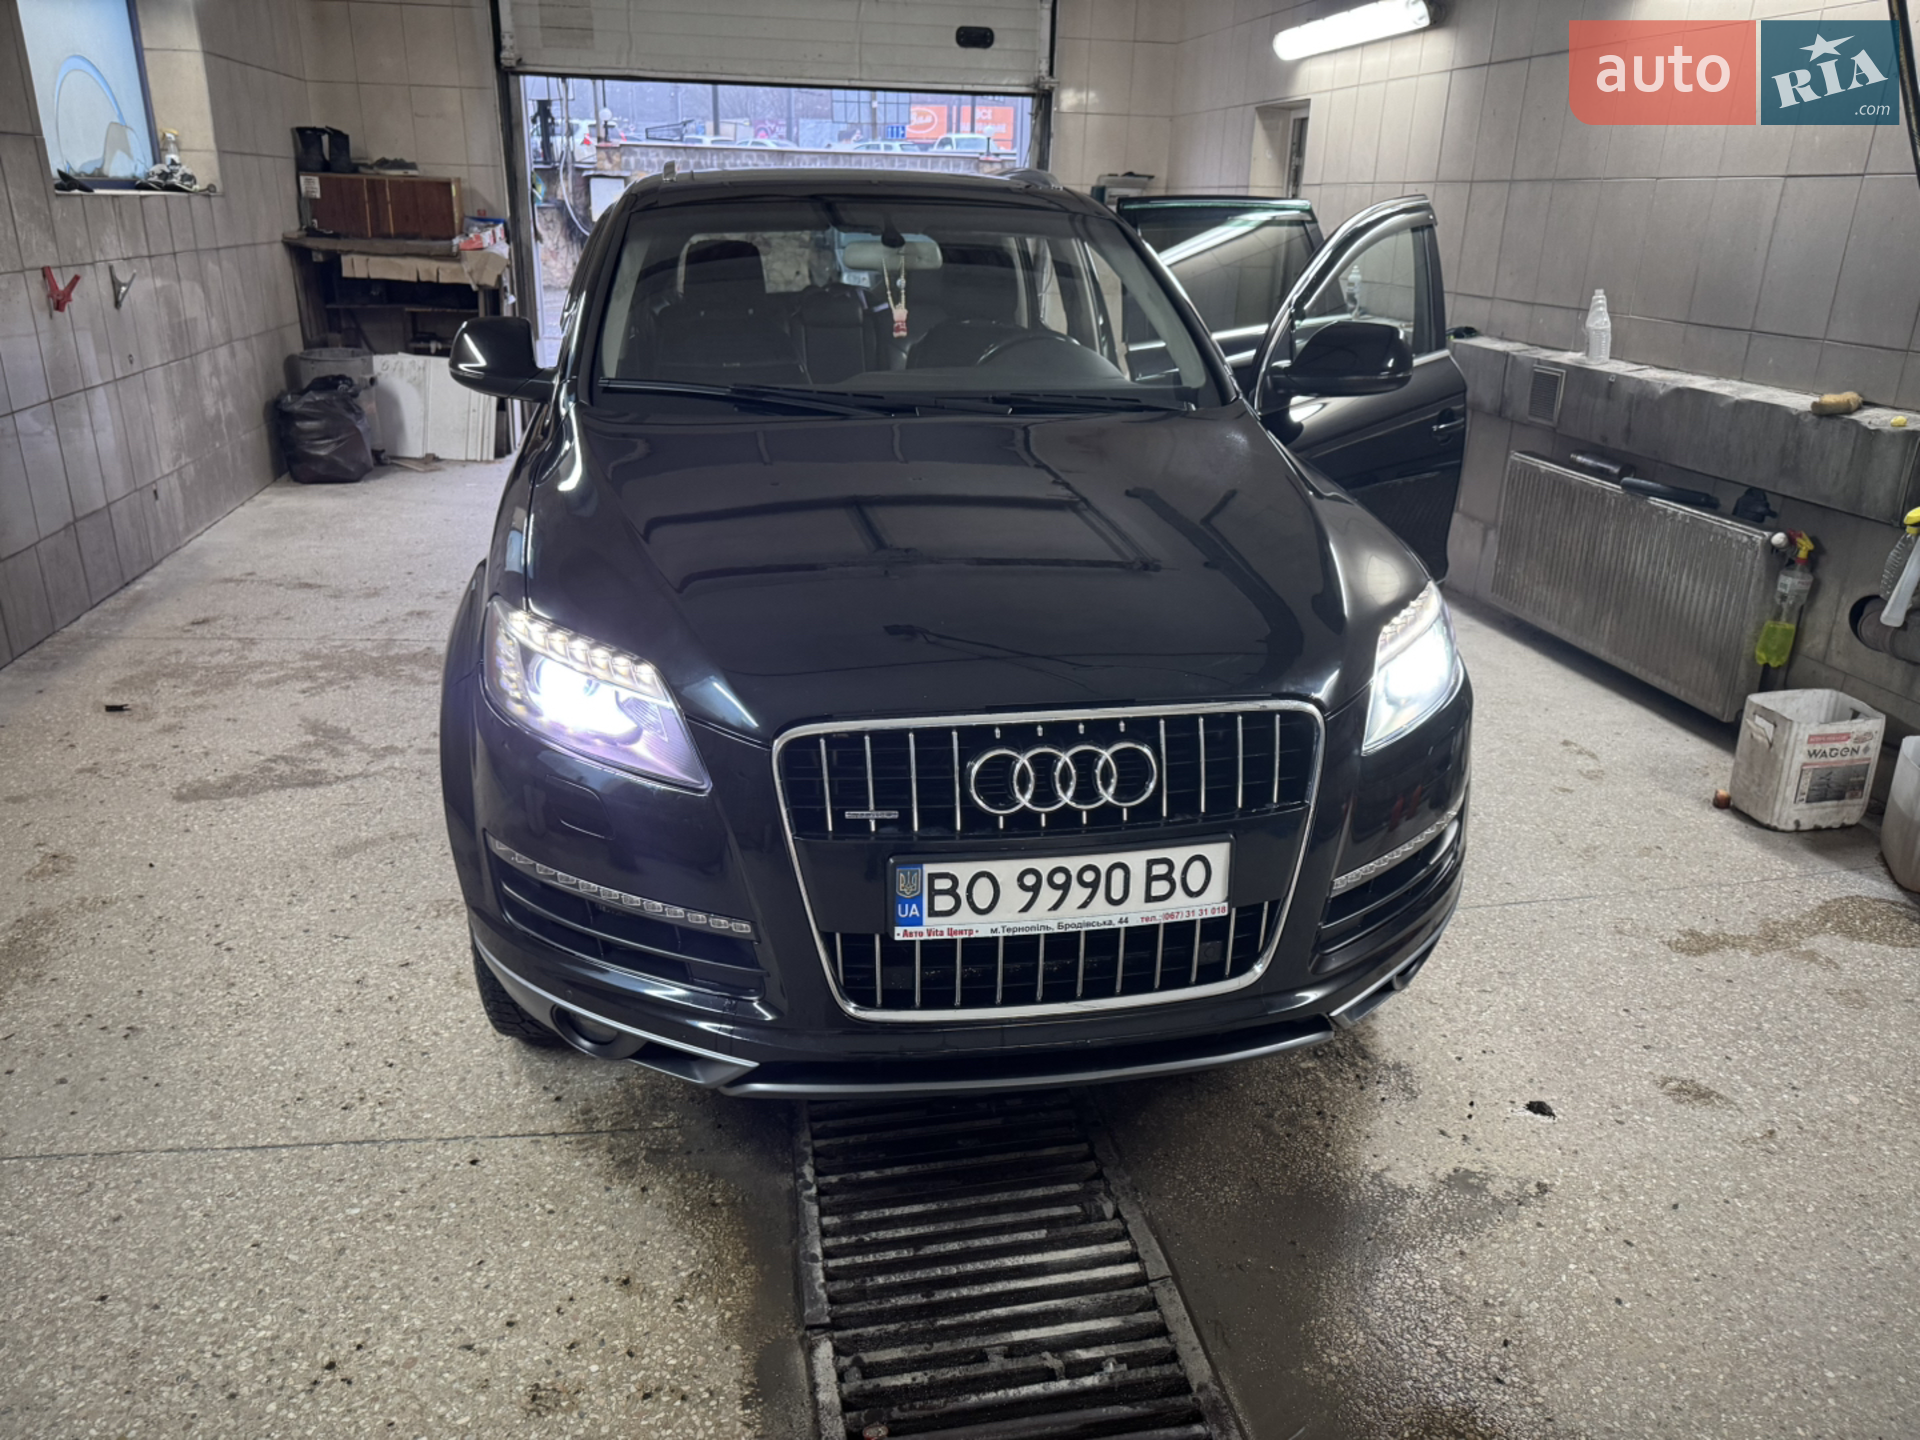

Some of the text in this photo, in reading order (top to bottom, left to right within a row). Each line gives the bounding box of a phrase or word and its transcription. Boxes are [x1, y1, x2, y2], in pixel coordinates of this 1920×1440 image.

[926, 854, 1213, 918] BO 9990 BO
[897, 903, 920, 918] UA
[902, 928, 924, 938] Авто
[926, 927, 945, 937] Vita
[947, 927, 974, 937] Центр
[1117, 916, 1129, 924] 44
[1185, 909, 1196, 918] 31
[1198, 908, 1208, 917] 31
